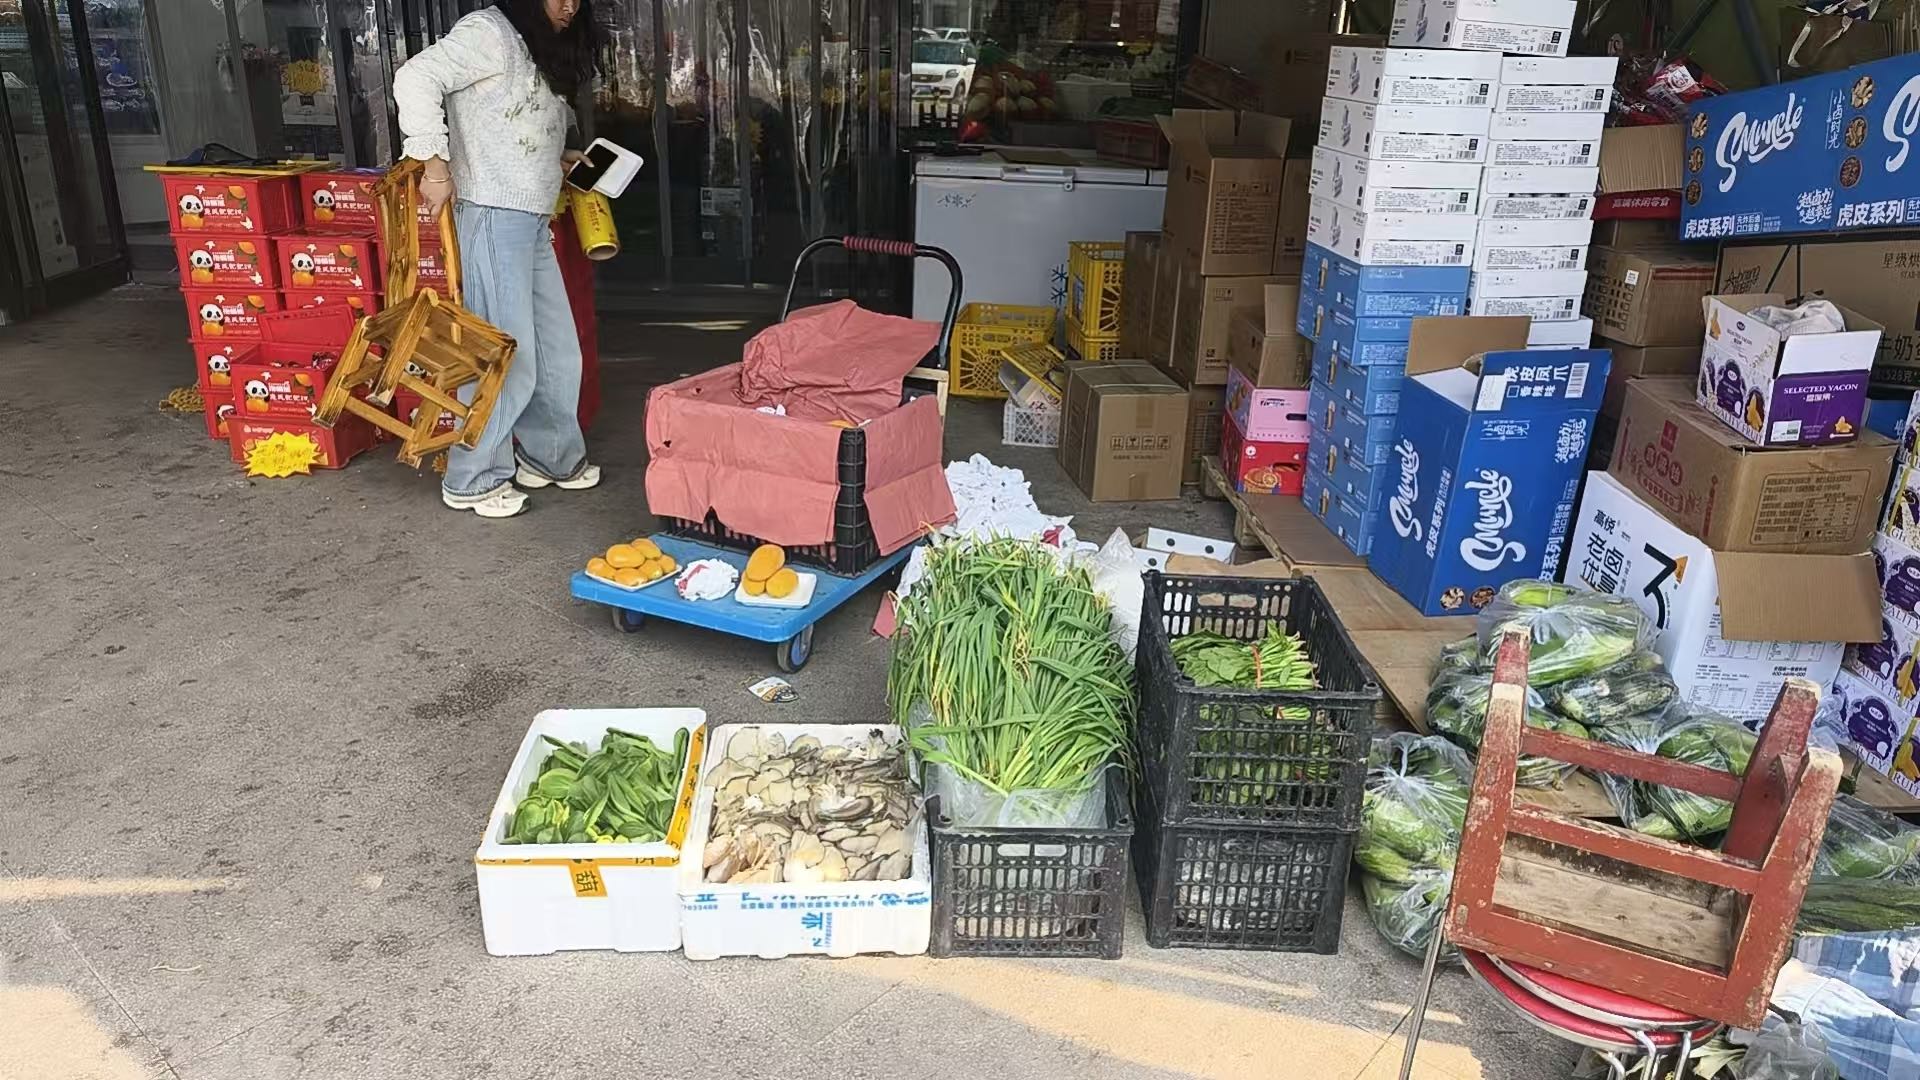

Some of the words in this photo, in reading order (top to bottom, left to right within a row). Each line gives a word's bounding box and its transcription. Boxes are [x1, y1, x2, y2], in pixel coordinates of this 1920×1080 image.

[1837, 199, 1905, 226] 虎皮系列
[1684, 215, 1736, 238] 虎皮系列
[1783, 385, 1826, 395] SELECTED
[1828, 383, 1859, 392] YACON
[1425, 497, 1446, 559] 虎皮系列
[1539, 536, 1565, 582] 皮系列
[1888, 687, 1916, 714] FRIT
[1893, 771, 1920, 799] RUIT
[575, 870, 599, 893] 葫
